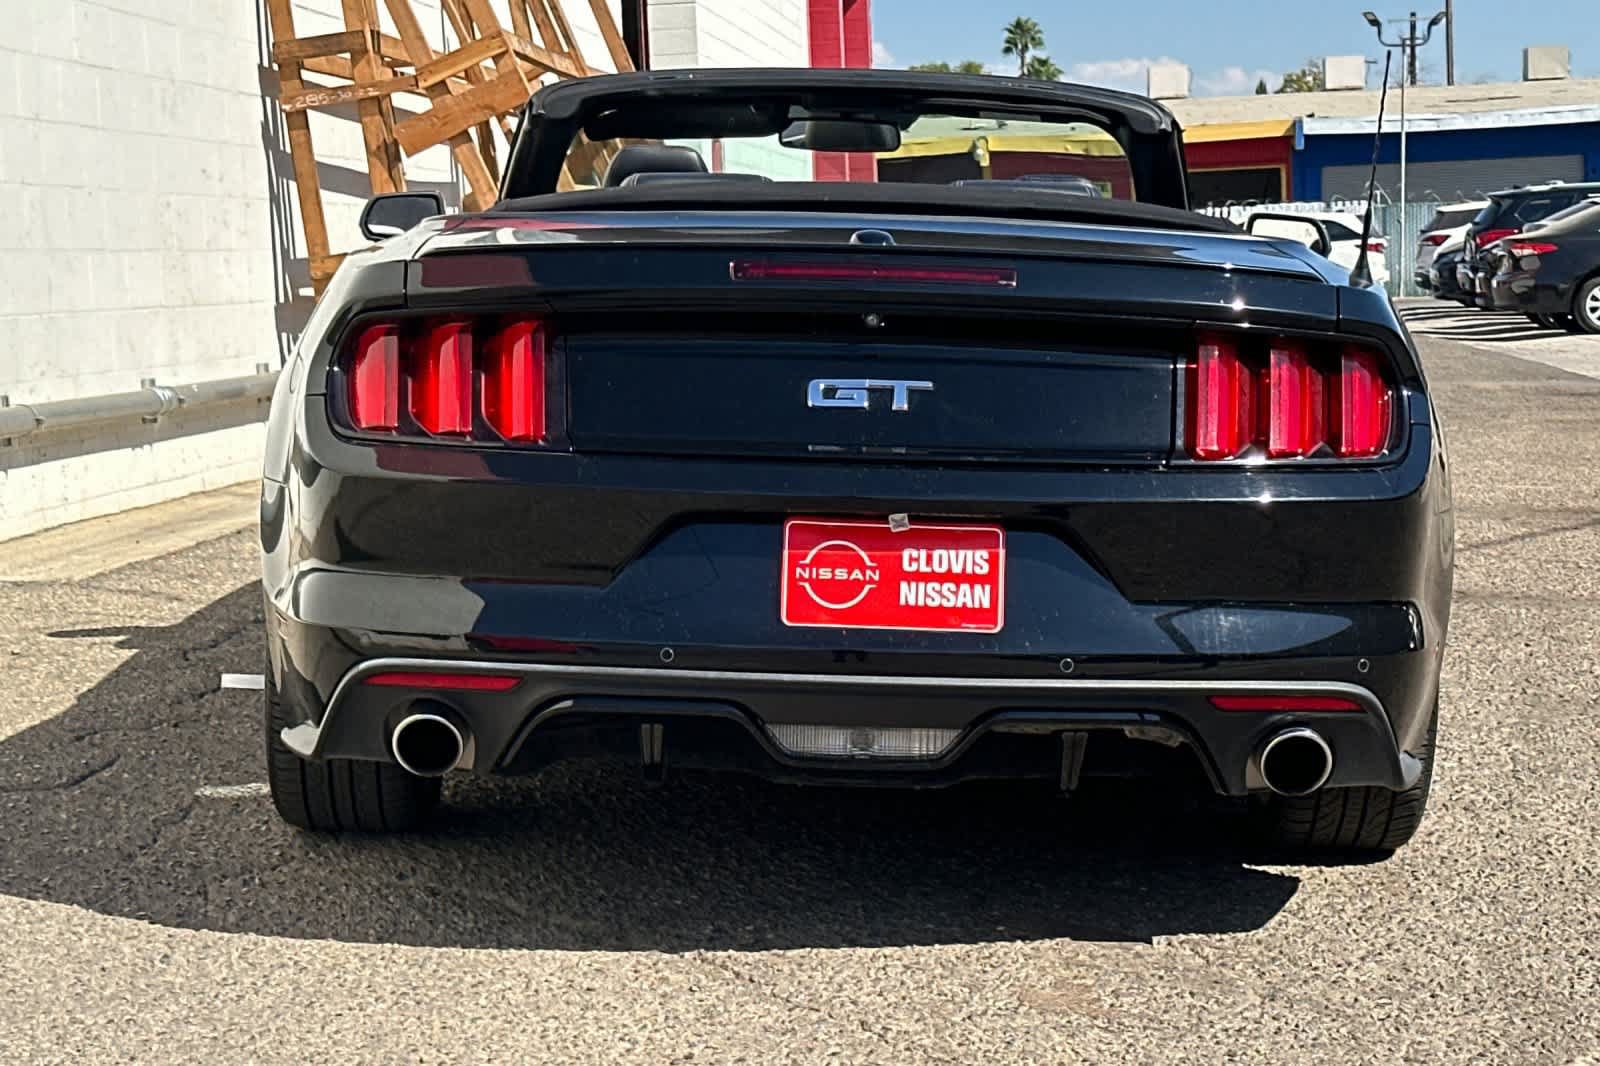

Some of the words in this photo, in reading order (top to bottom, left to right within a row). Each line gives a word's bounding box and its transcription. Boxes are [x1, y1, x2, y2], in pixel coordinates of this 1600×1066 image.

[807, 379, 934, 411] GT
[795, 567, 880, 582] NISSAN
[902, 548, 990, 575] CLOVIS
[899, 581, 991, 609] NISSAN
